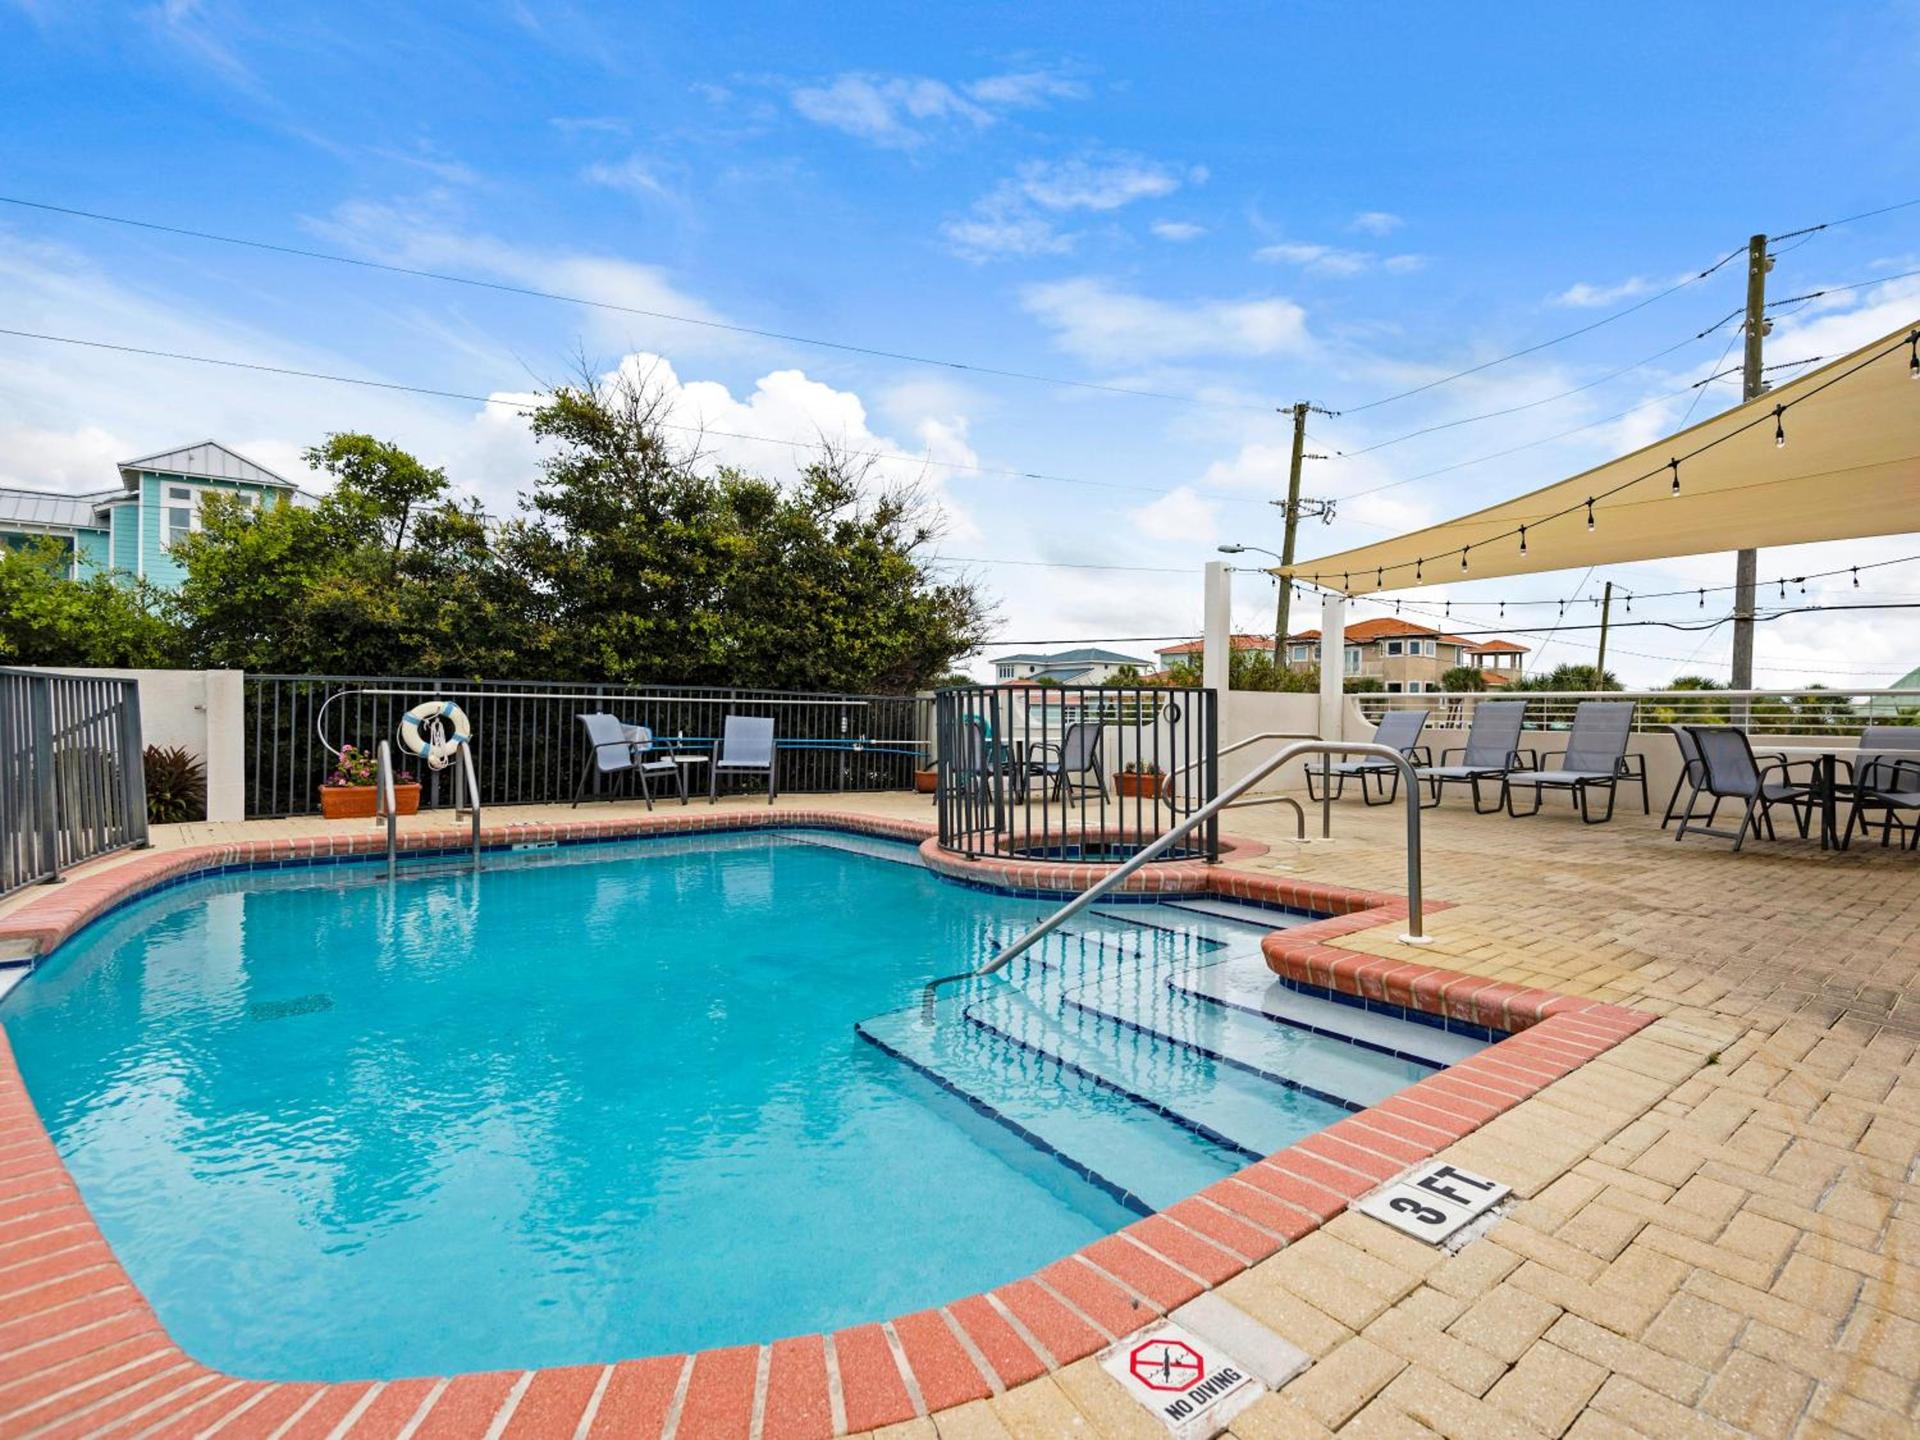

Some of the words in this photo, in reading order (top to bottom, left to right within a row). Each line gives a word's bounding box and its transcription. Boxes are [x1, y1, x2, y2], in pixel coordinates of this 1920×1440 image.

[1389, 1197, 1447, 1225] 3
[1164, 1399, 1194, 1421] NO
[1188, 1367, 1242, 1405] DIVING
